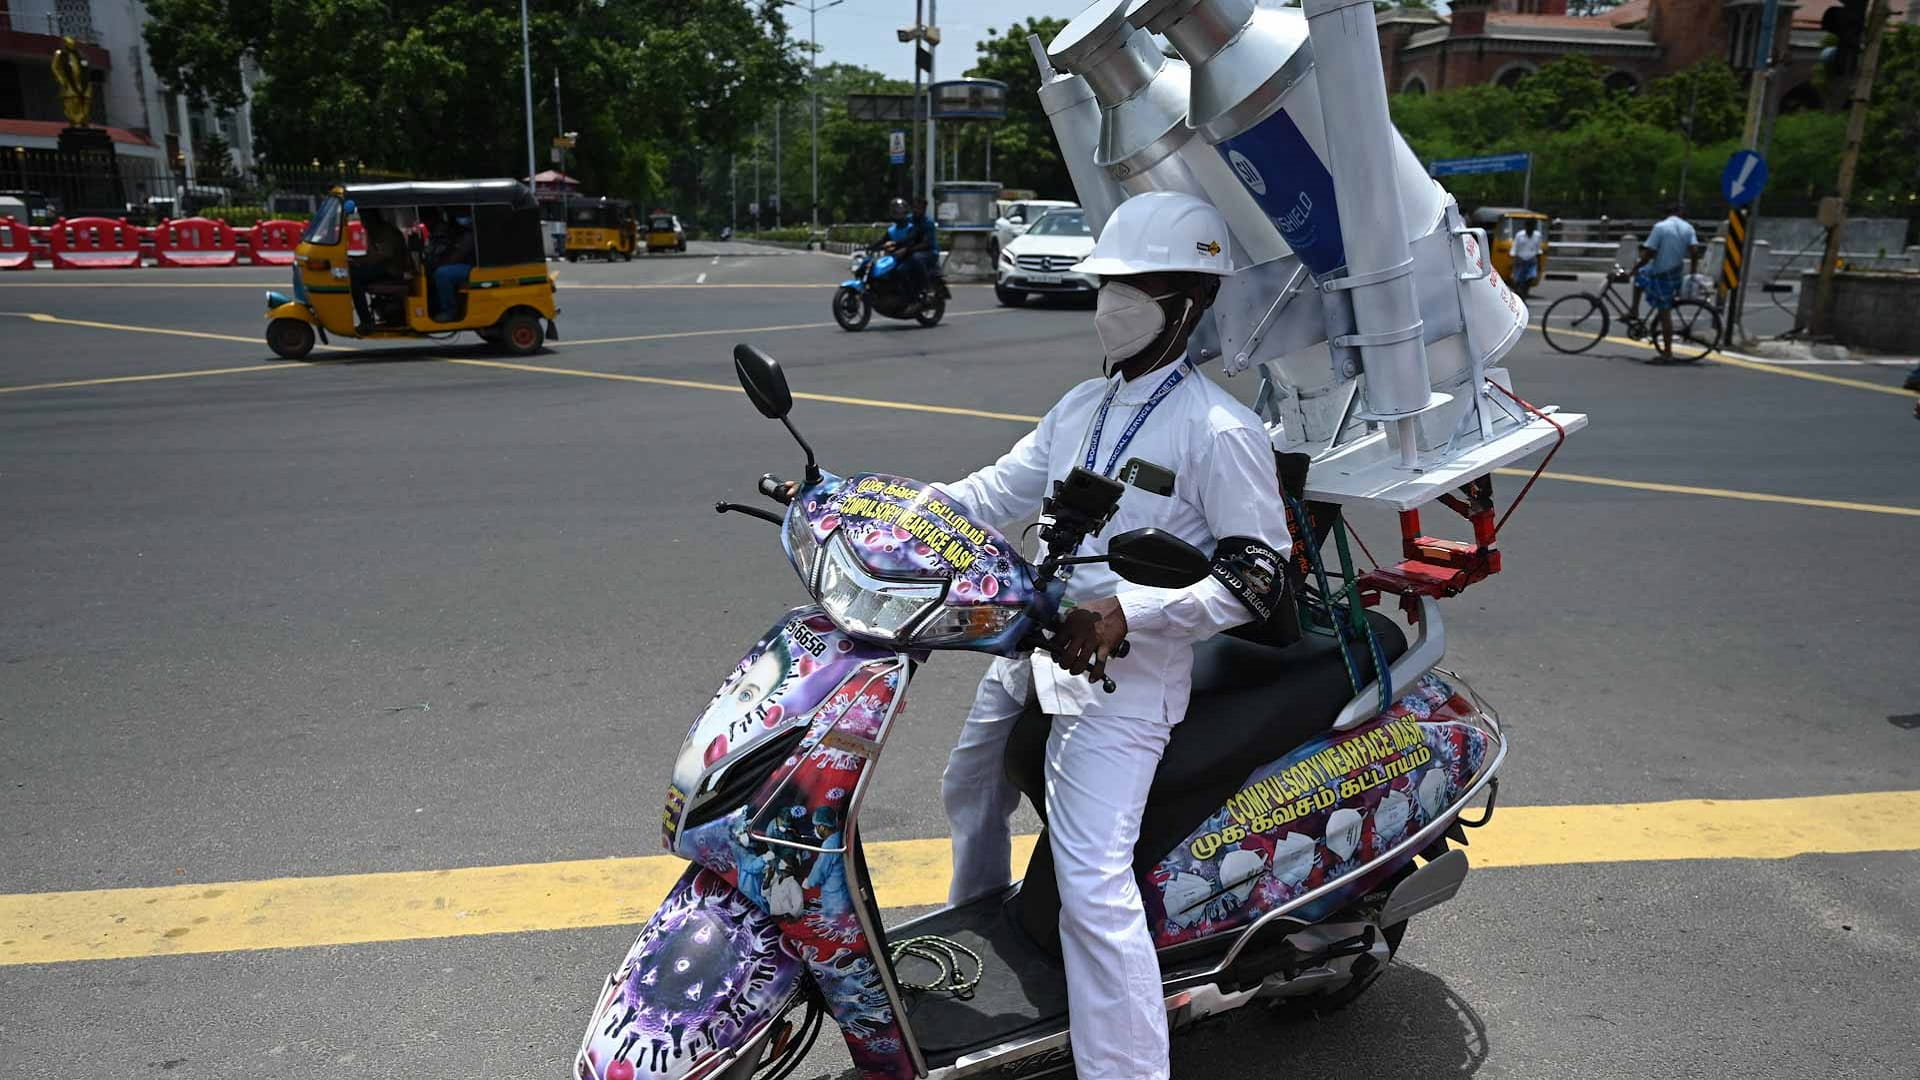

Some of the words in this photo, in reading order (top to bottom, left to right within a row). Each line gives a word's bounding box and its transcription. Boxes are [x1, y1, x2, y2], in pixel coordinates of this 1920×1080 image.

[1108, 437, 1128, 466] SOCIAL
[1125, 404, 1152, 437] SERVICE
[841, 497, 900, 524] COMPULSORY
[942, 540, 976, 573] MASK
[1241, 586, 1272, 621] BRIGAD
[793, 624, 828, 658] 6658
[1190, 824, 1247, 861] முக
[1250, 785, 1337, 834] கவசம்
[1339, 744, 1433, 800] கட்டாயம்
[1226, 758, 1326, 825] COMPULSORY
[1387, 714, 1426, 752] MASK
